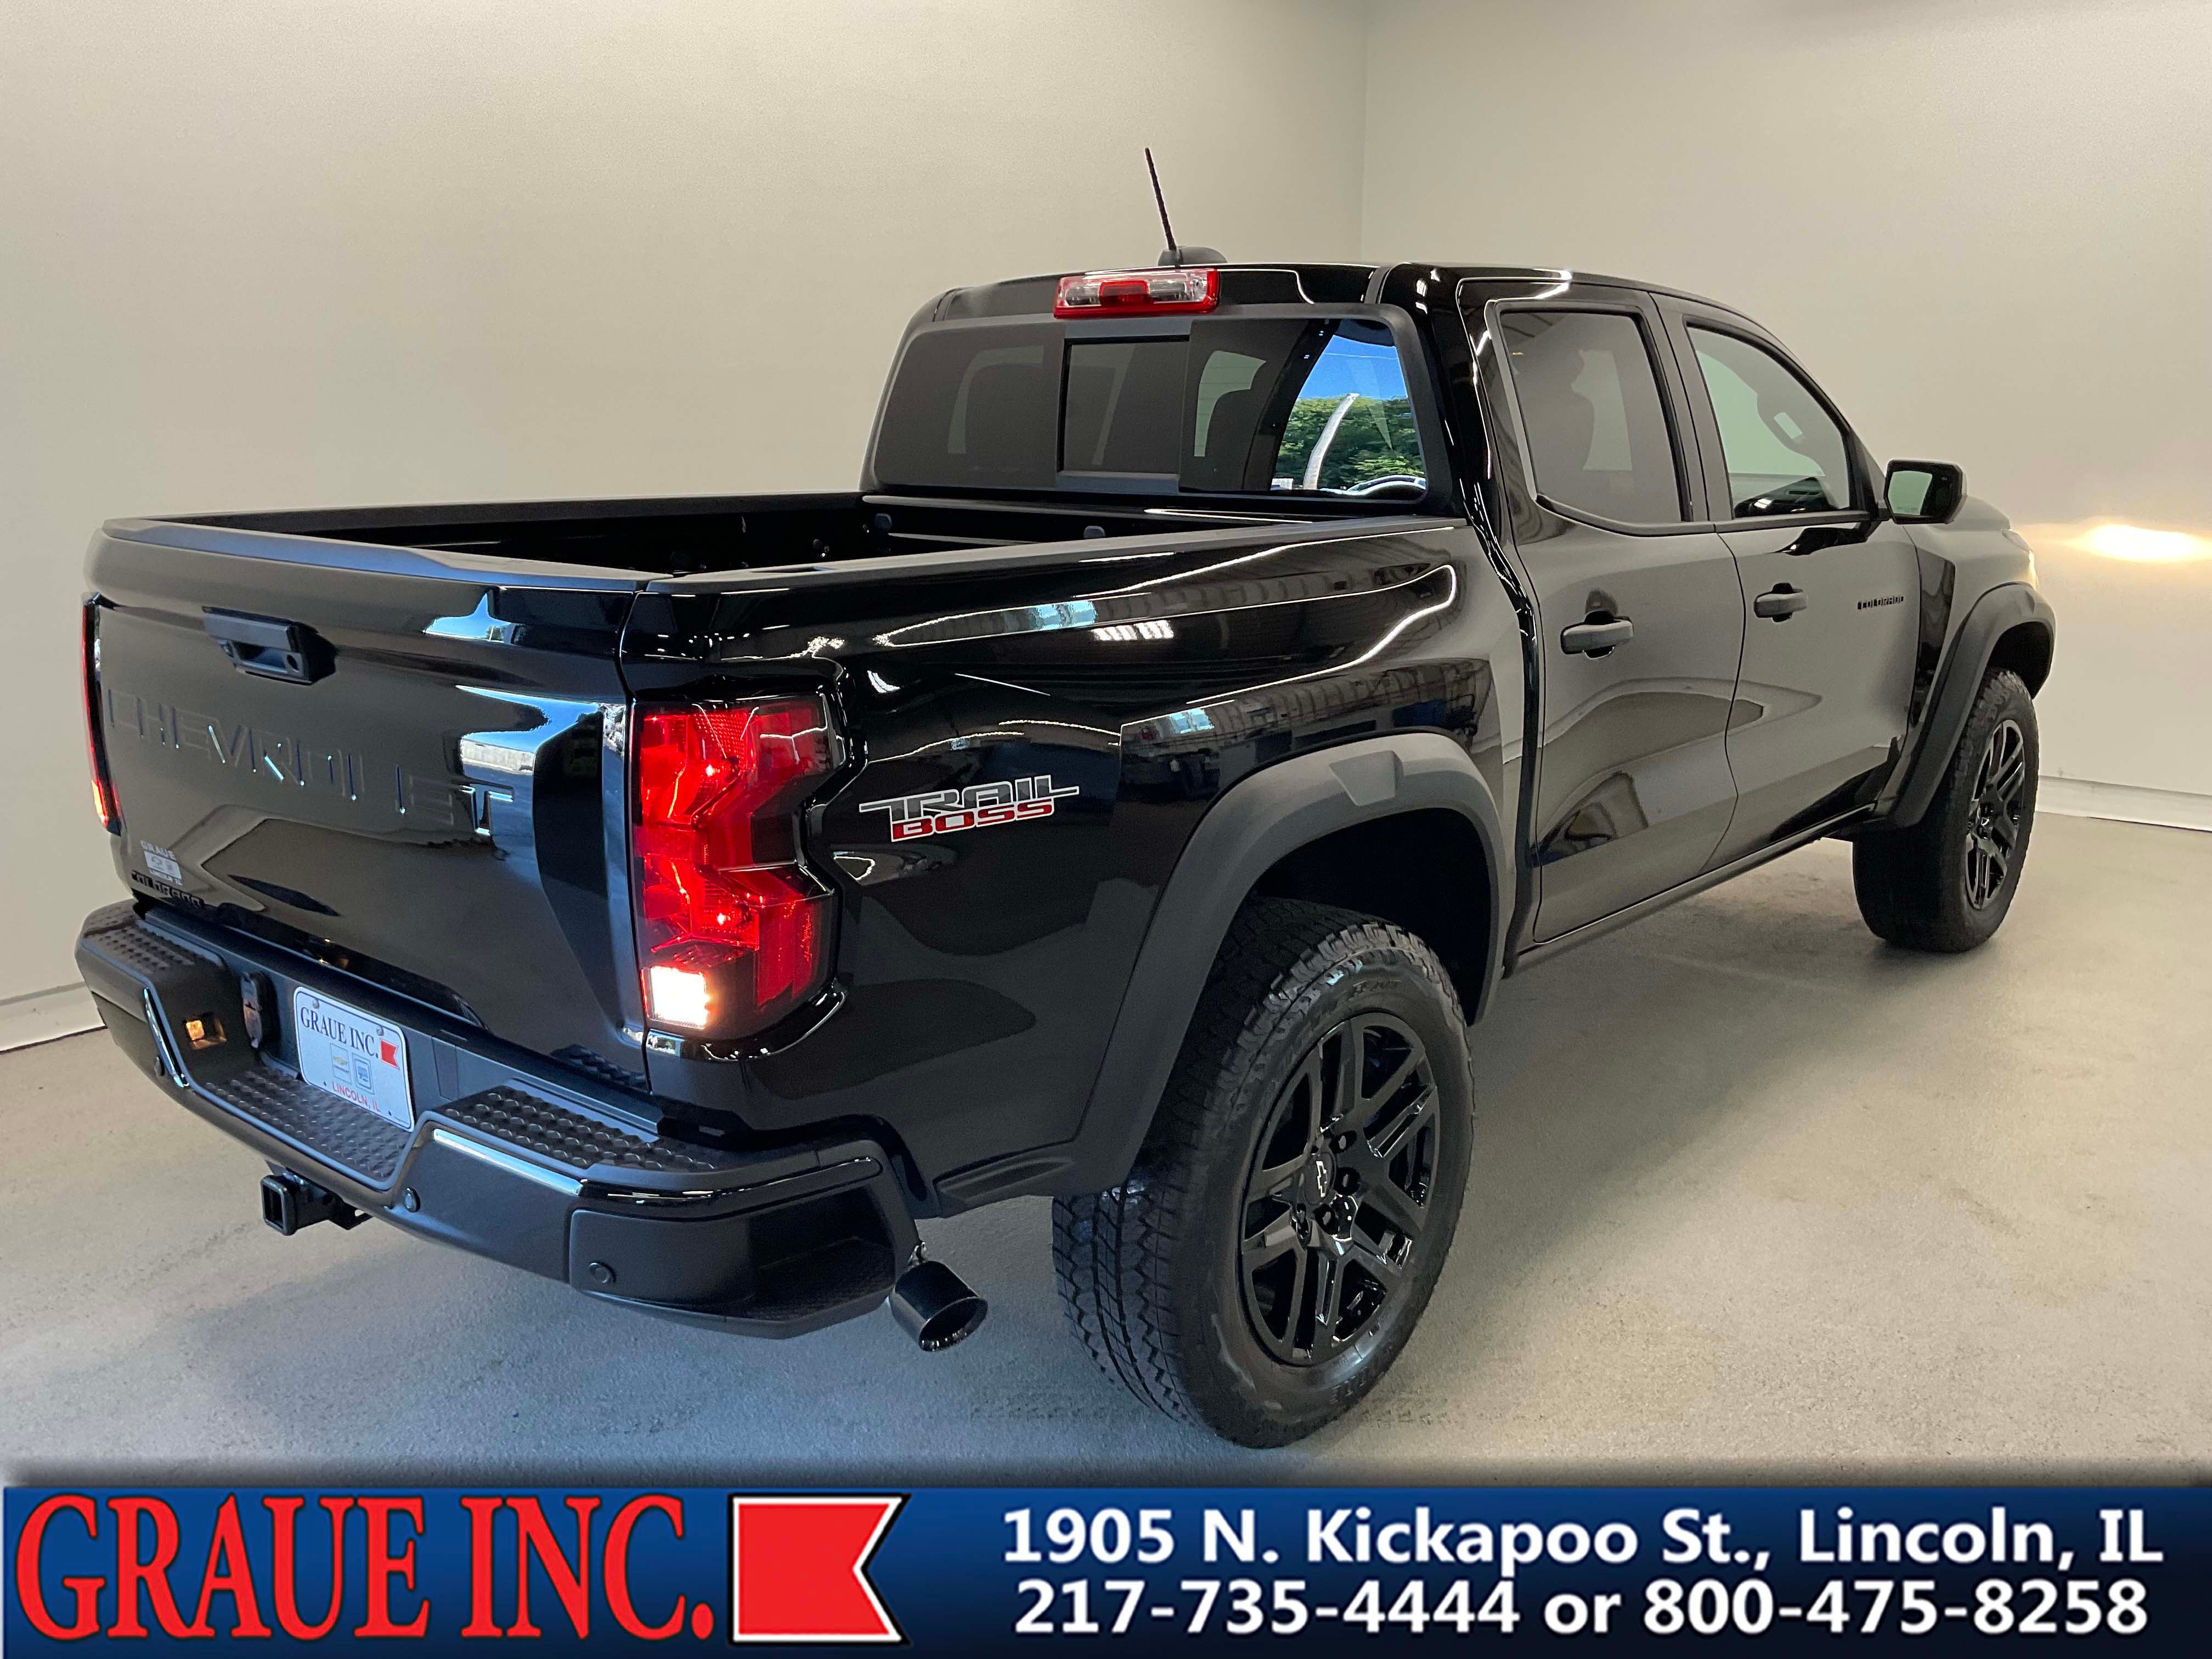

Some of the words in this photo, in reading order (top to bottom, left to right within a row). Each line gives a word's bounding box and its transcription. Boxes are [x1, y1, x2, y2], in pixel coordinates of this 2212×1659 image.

[859, 774, 1080, 821] TRAIL
[890, 798, 1054, 842] BOSS
[140, 840, 176, 861] GRAUE
[301, 1006, 347, 1045] GRAUE
[349, 1027, 379, 1059] INC.
[372, 1099, 381, 1113] IL
